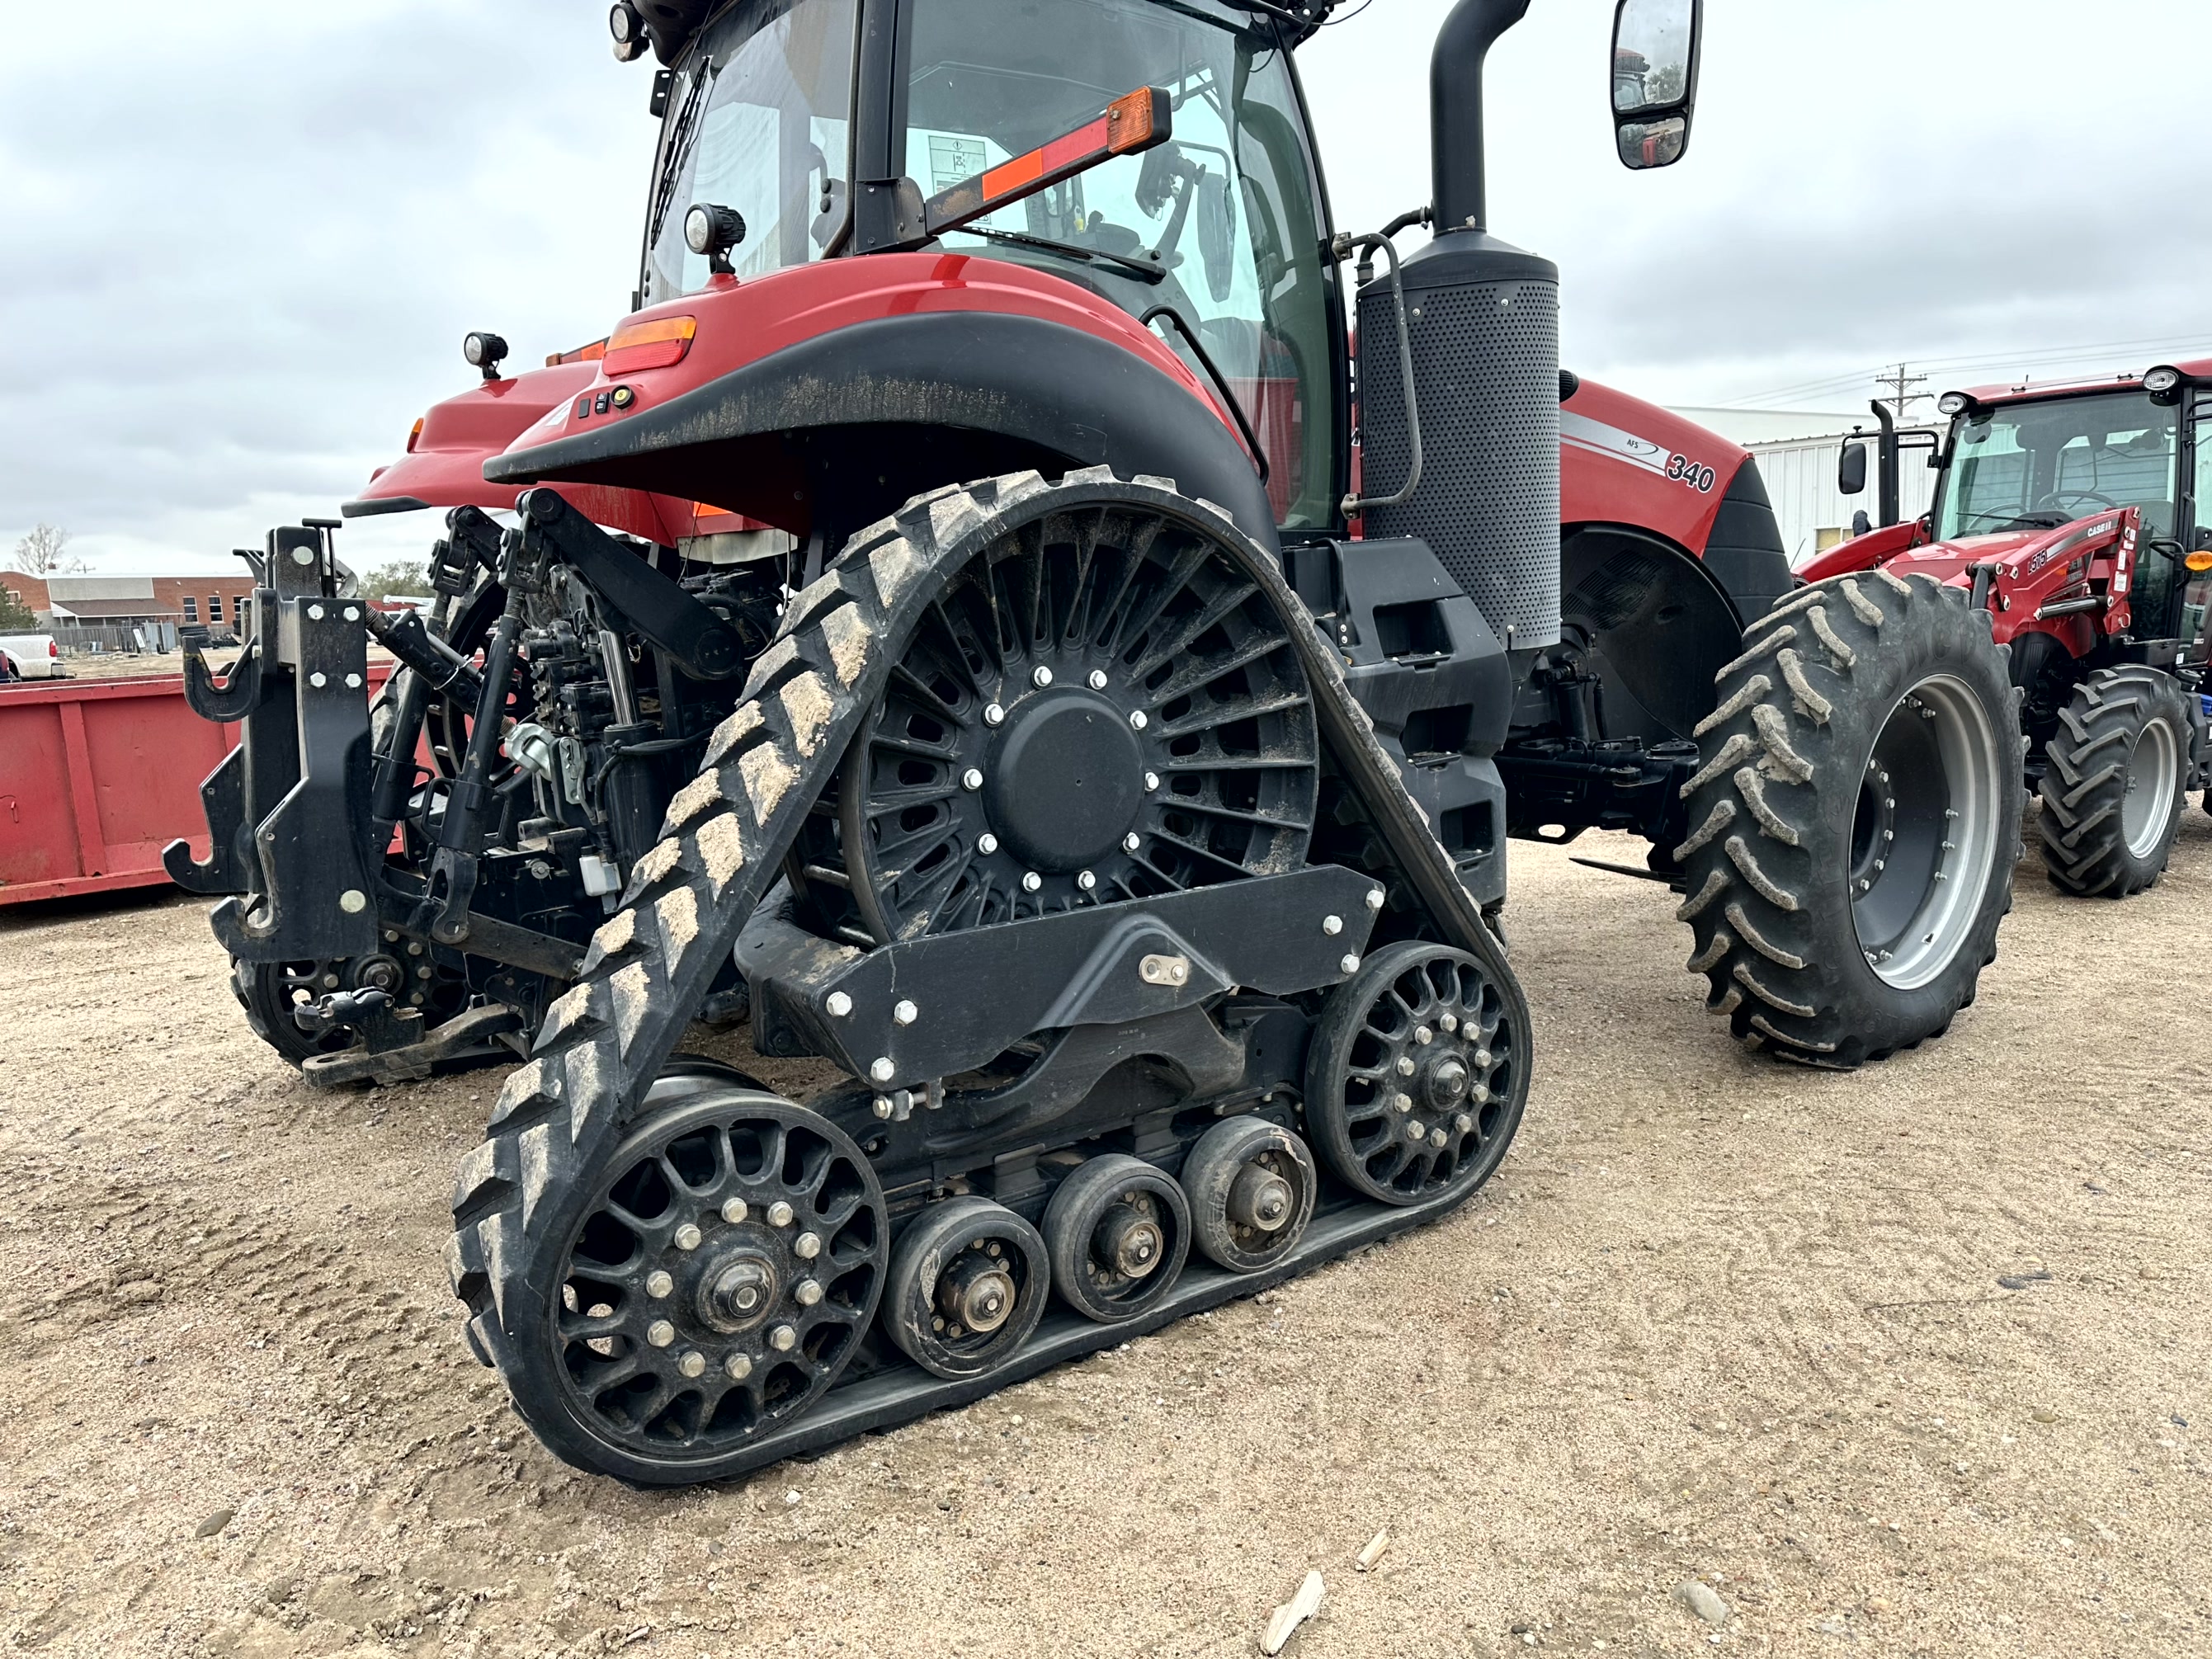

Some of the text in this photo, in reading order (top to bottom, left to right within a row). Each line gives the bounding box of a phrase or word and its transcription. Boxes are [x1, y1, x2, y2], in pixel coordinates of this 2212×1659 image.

[1627, 439, 1639, 449] AFS
[1667, 454, 1715, 493] 340
[2087, 523, 2106, 538] CASE
[2027, 548, 2047, 576] L575
